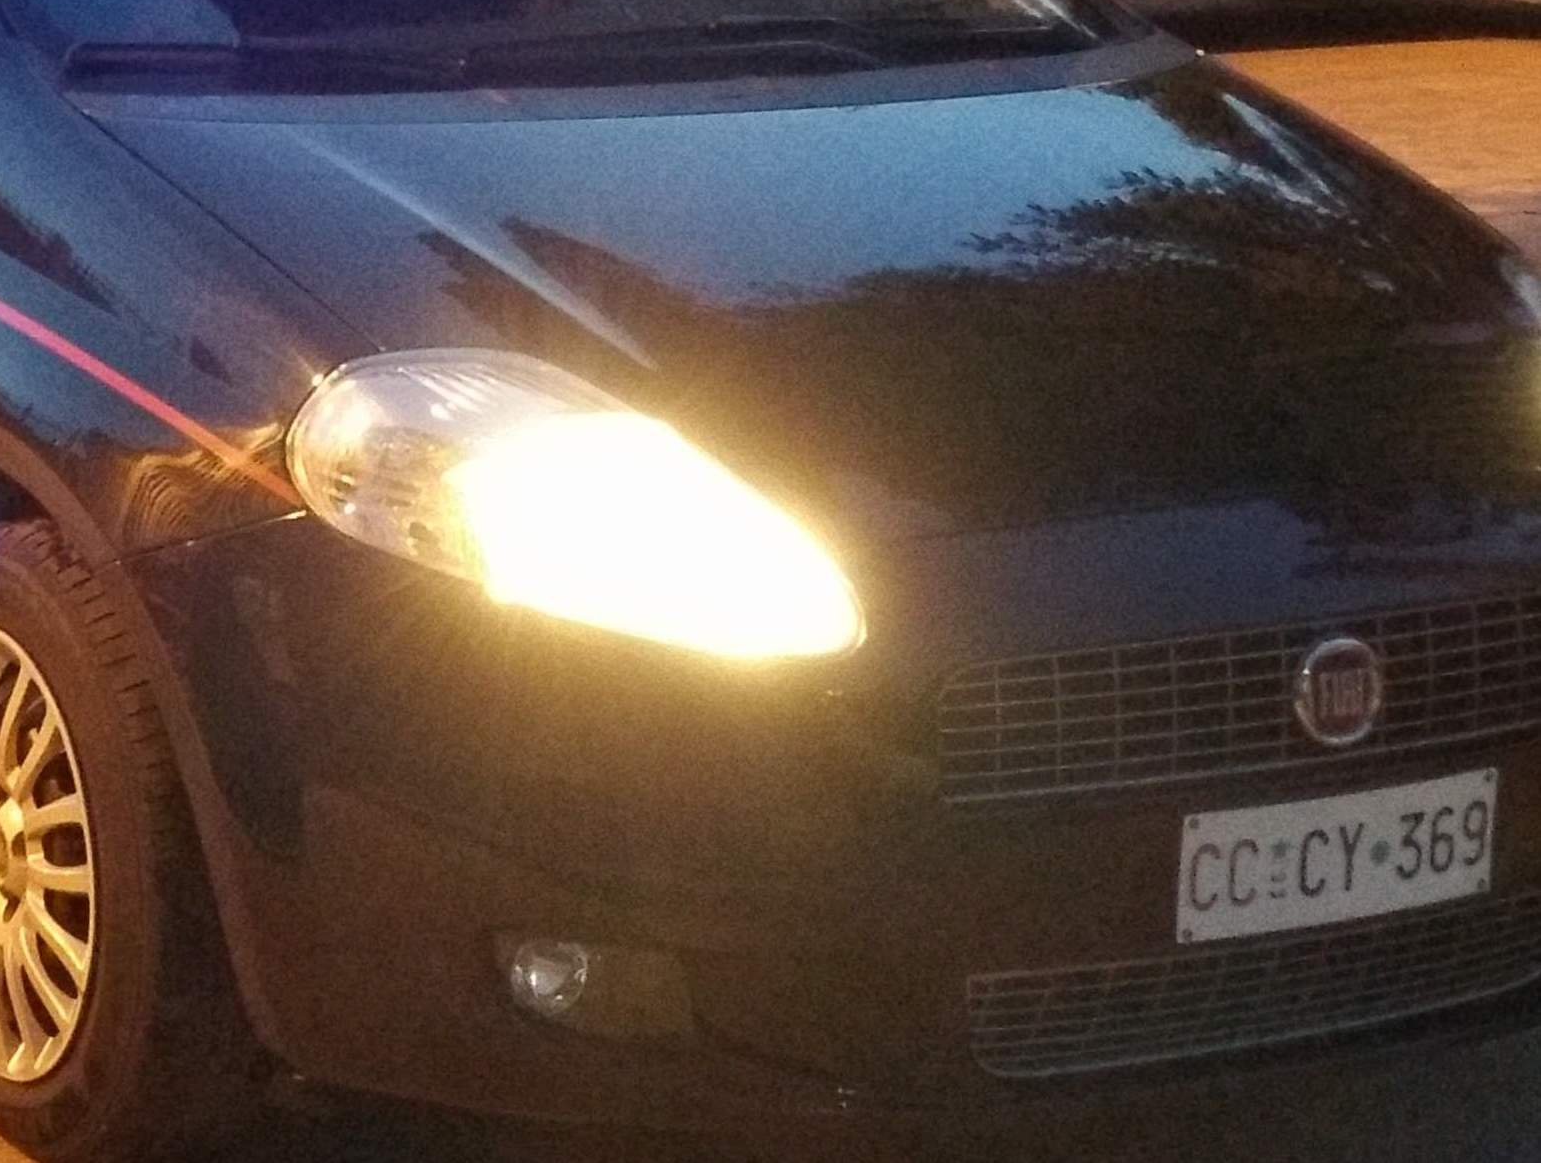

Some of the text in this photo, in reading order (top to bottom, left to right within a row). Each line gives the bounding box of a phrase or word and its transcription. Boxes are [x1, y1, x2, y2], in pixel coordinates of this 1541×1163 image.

[1190, 837, 1260, 911] CC
[1299, 822, 1364, 898] CY
[1395, 800, 1489, 880] 369
